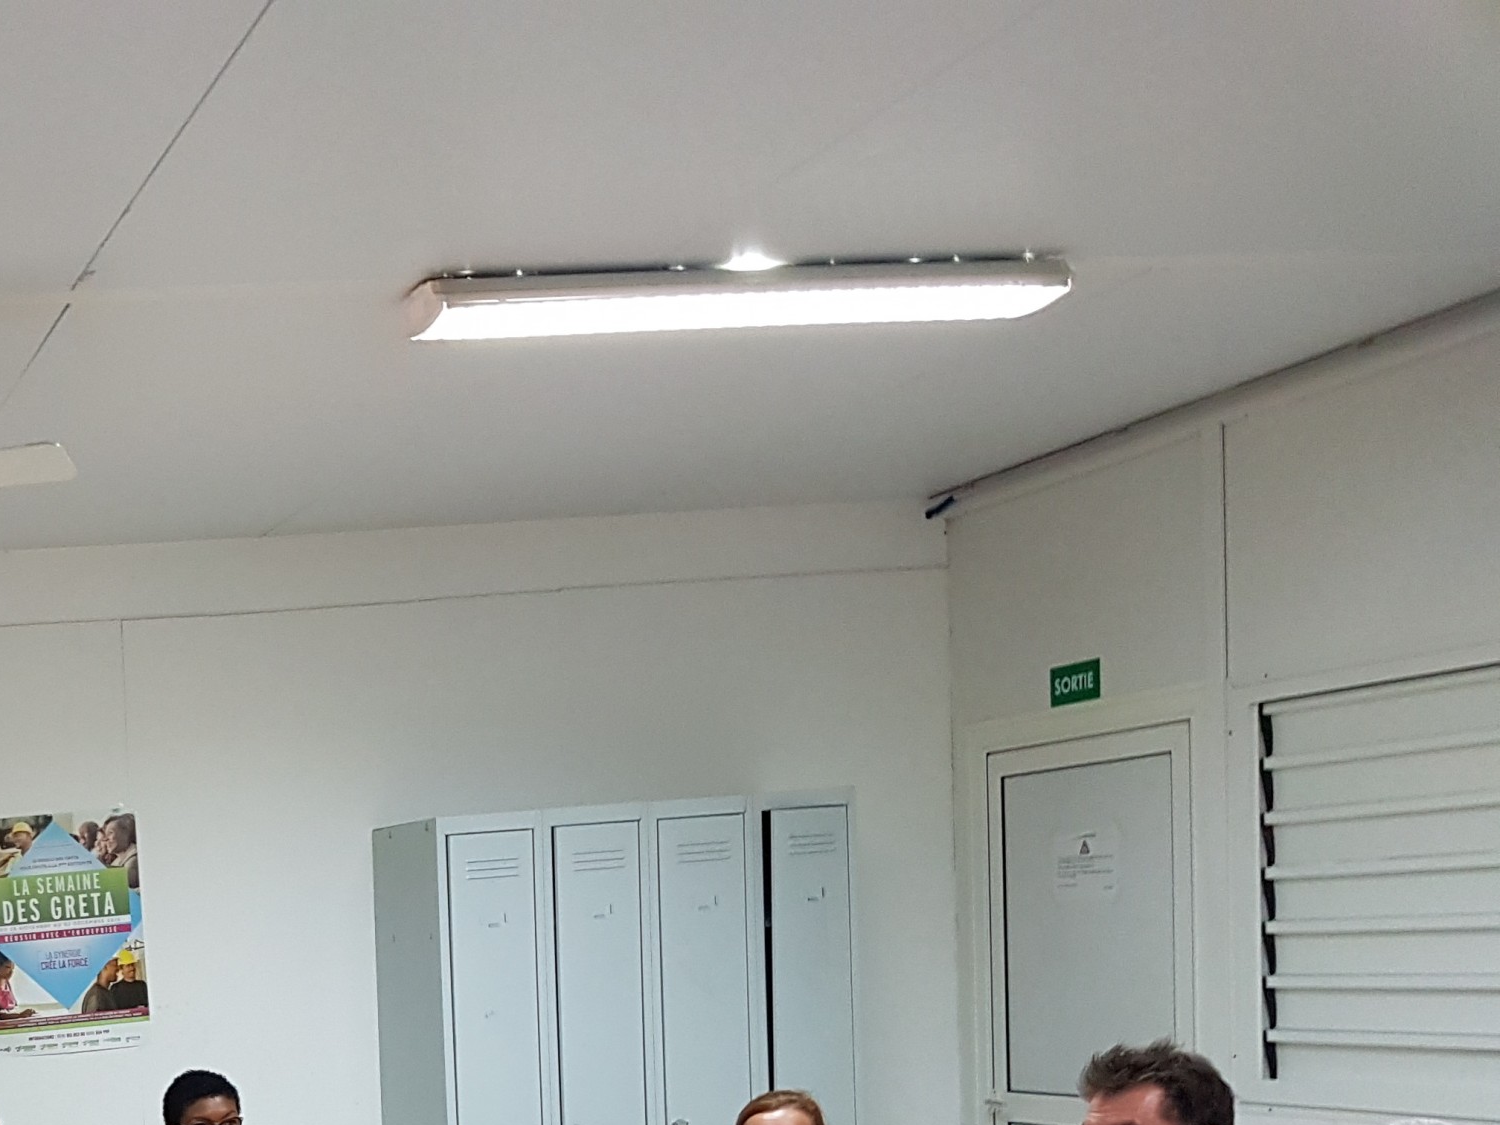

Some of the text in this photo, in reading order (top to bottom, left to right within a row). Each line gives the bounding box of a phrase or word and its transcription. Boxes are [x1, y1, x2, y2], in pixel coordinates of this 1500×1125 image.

[1054, 671, 1094, 696] SORTIE
[13, 872, 101, 896] LA SEMAINE
[2, 891, 116, 924] DES GRETA
